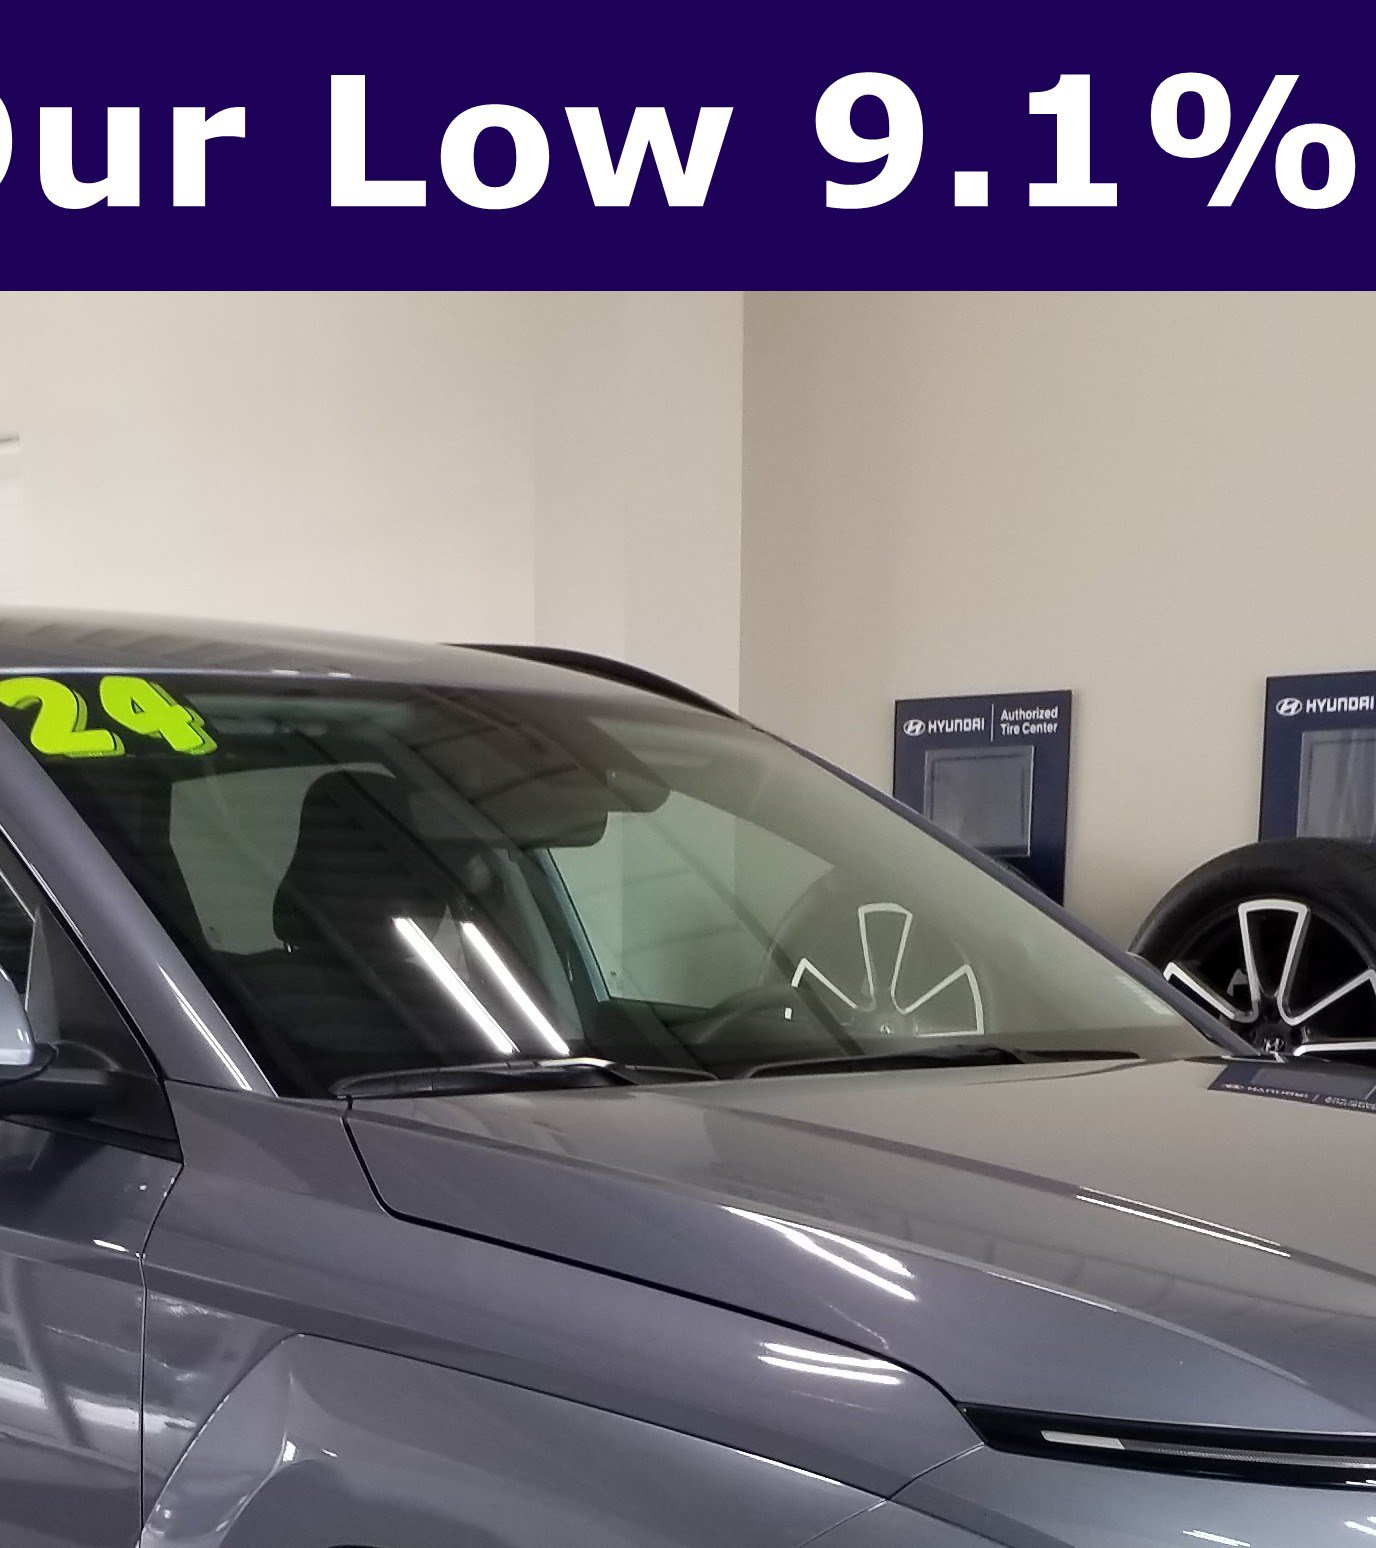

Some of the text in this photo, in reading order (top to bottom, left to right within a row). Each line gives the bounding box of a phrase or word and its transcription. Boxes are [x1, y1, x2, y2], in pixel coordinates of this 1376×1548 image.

[1000, 705, 1059, 722] Authorized
[1305, 695, 1375, 715] HYUNDAI
[928, 716, 985, 734] HYUNDAI
[1000, 721, 1059, 736] Tire Center
